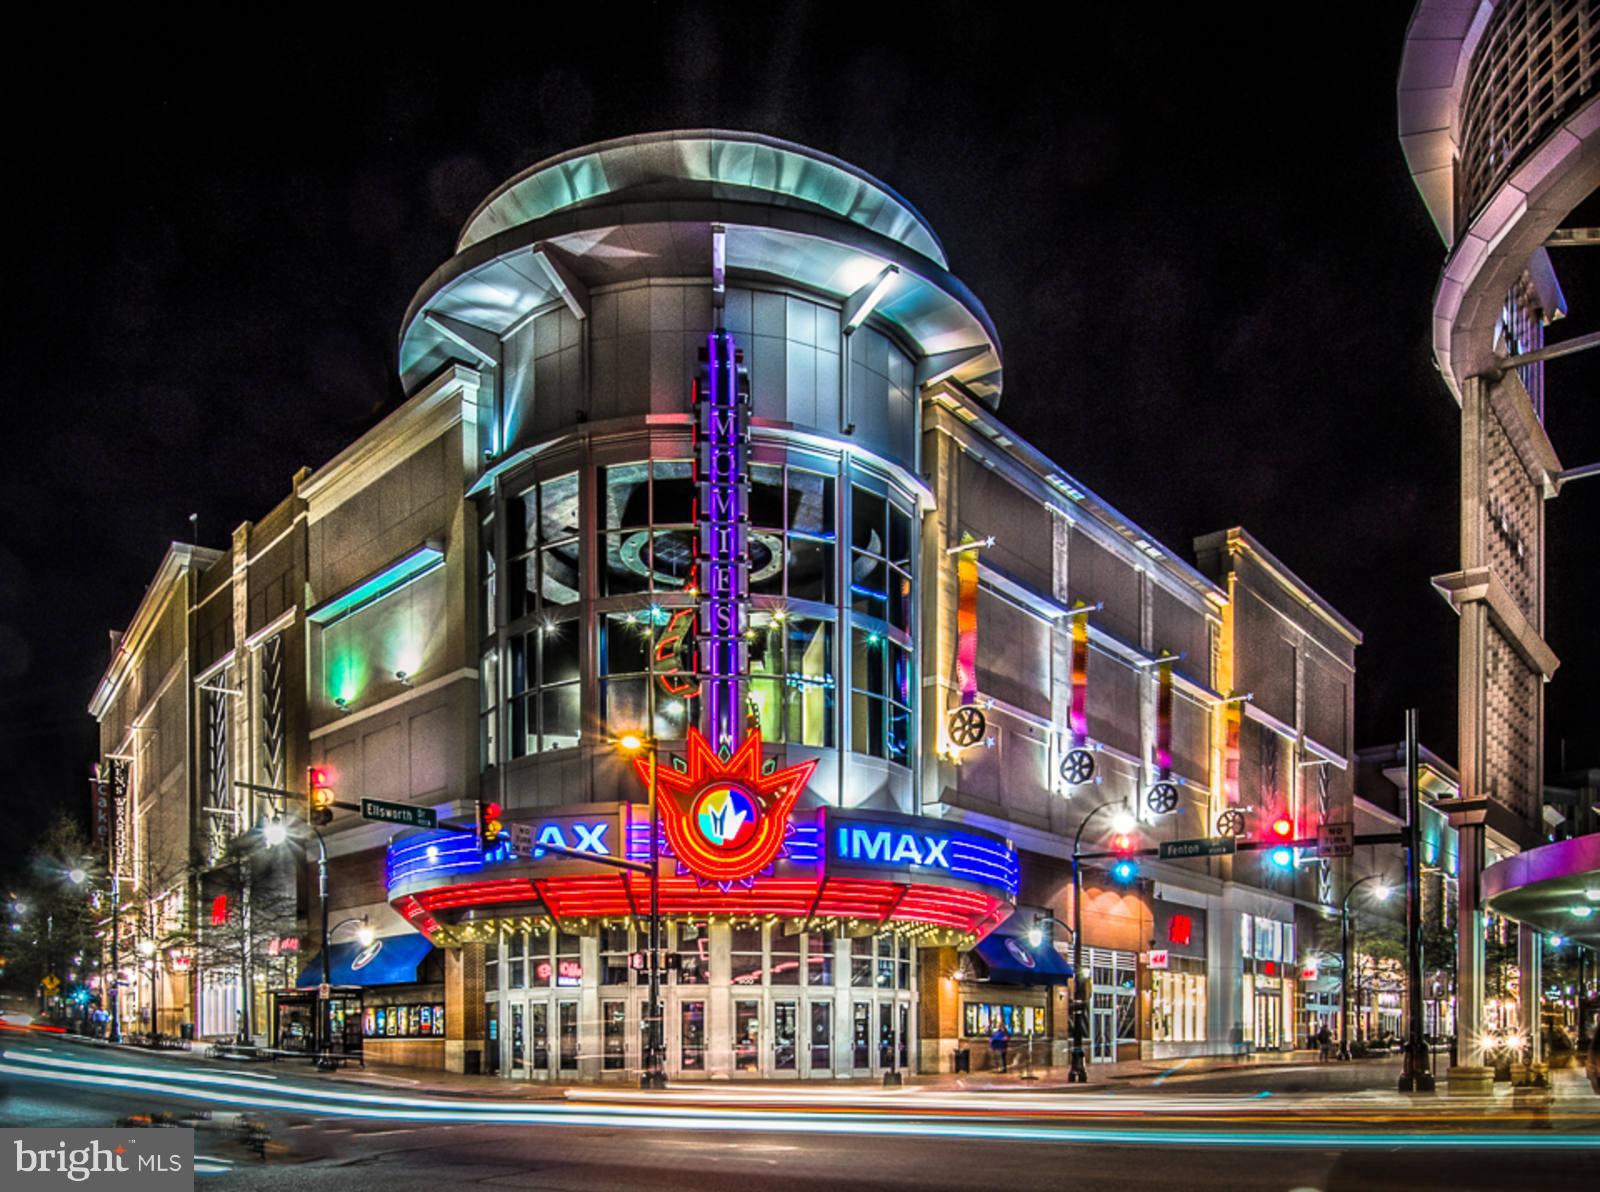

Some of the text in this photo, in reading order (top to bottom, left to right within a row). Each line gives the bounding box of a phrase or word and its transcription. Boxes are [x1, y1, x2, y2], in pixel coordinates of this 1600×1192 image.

[713, 413, 736, 632] MOVIES
[366, 802, 413, 822] Ellsworth
[838, 828, 951, 869] IMAX
[1167, 843, 1200, 856] Fenton
